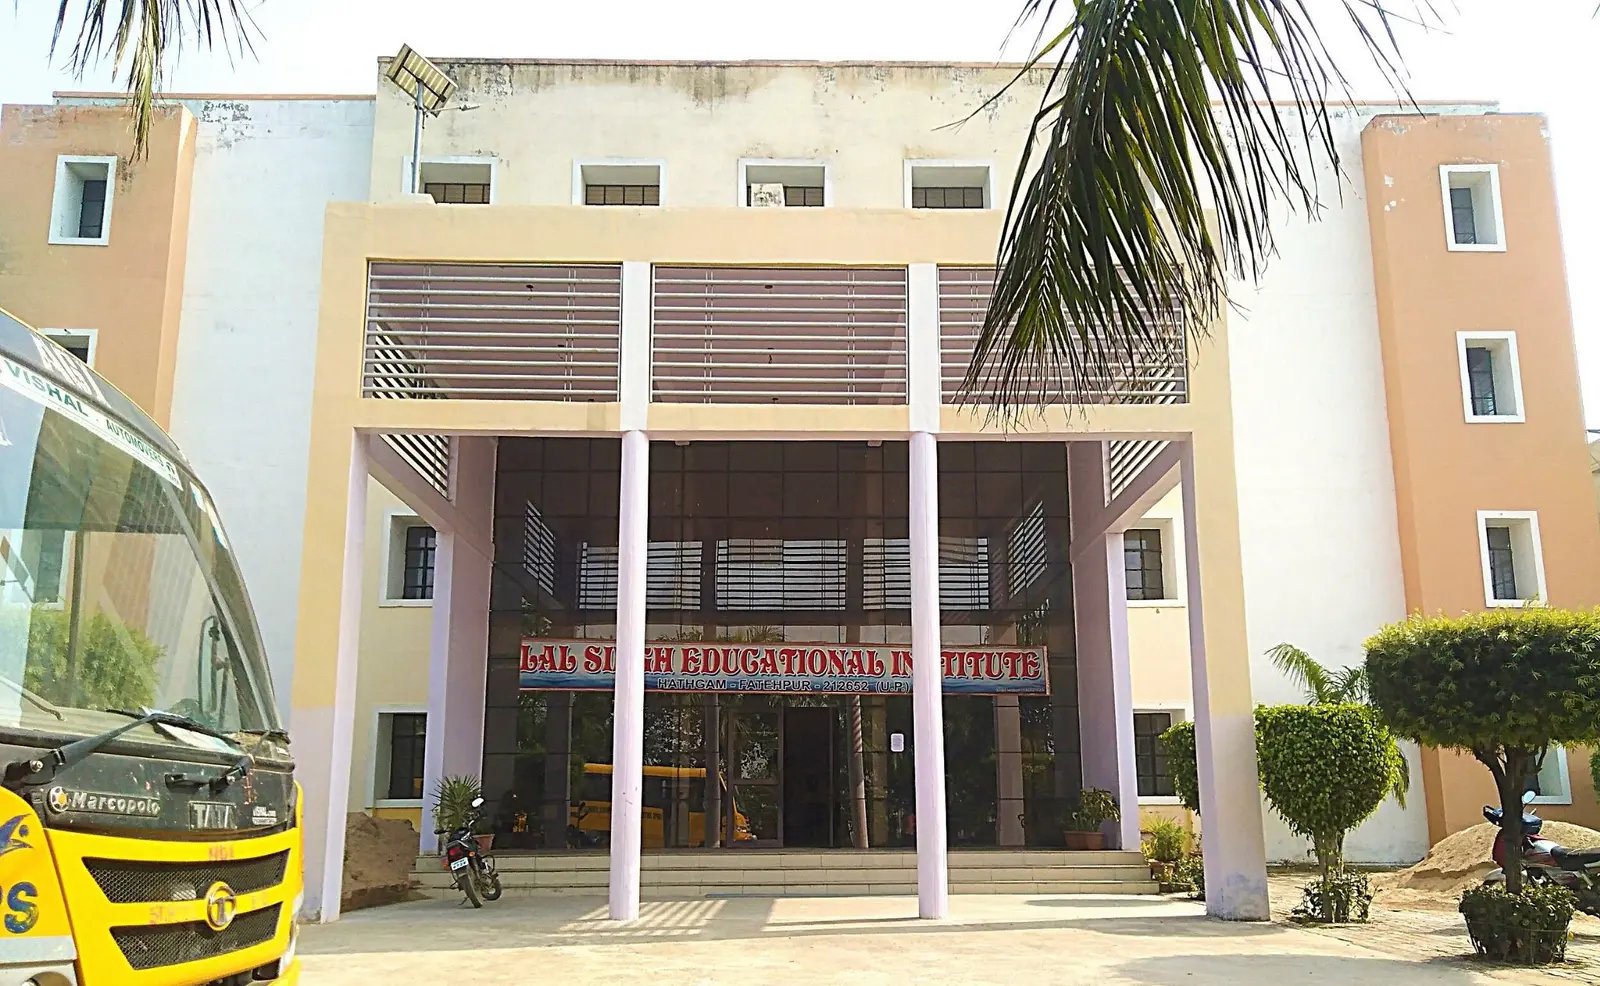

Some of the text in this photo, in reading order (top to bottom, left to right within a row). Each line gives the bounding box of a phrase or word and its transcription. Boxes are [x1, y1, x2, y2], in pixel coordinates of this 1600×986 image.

[3, 359, 89, 417] VISHAL
[520, 645, 1041, 681] LAL SIH EDUCATIONAL INTITUTE
[658, 678, 727, 690] HATHGAM
[739, 679, 812, 692] FATEHPUR
[823, 681, 869, 692] 212652
[72, 791, 160, 815] Marcopolo
[193, 803, 238, 829] TATA
[0, 881, 39, 934] S
